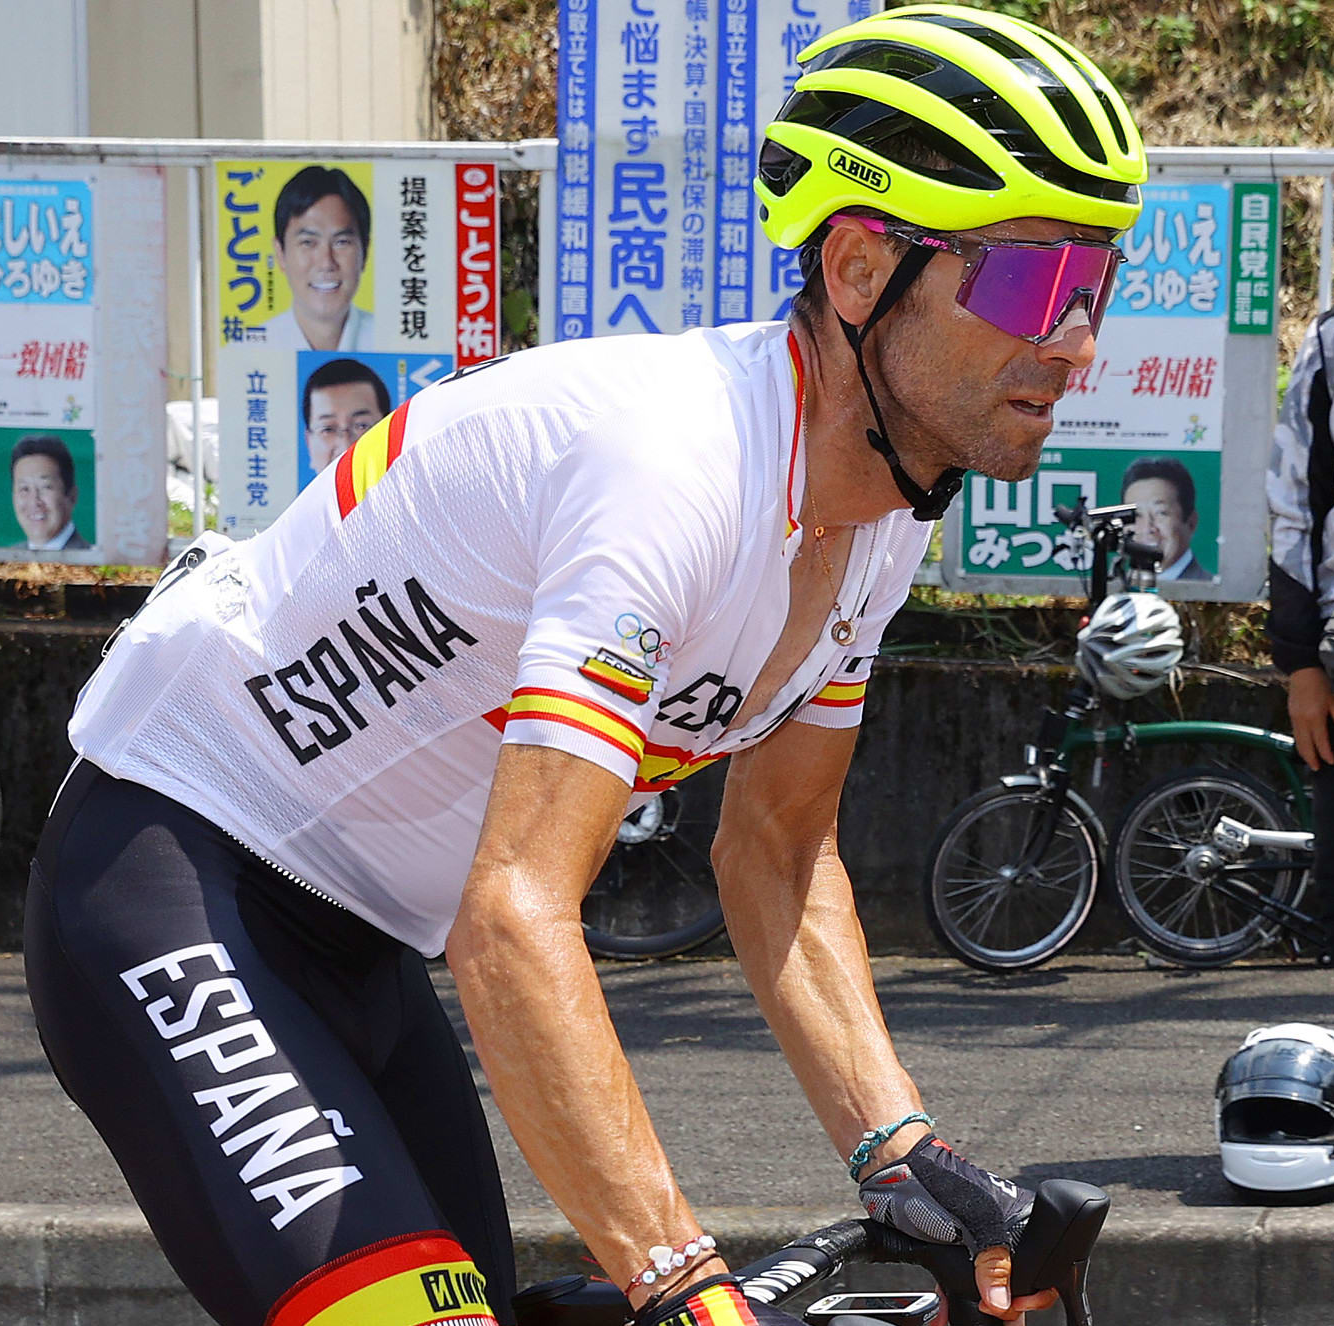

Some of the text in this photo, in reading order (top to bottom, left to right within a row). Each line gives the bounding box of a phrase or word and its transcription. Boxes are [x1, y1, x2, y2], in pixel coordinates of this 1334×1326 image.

[834, 156, 883, 188] ABUS
[1123, 204, 1221, 267] しいえ
[1239, 194, 1270, 278] 自民党
[224, 168, 264, 312] ごとう
[400, 177, 428, 340] 提案を実現
[458, 186, 496, 366] ごとう祐
[921, 236, 949, 250] 100%
[1115, 270, 1220, 312] ろゆき
[246, 371, 268, 506] 立憲民主党
[244, 577, 477, 766] ESPAÑA
[119, 942, 363, 1231] ESPAÑA
